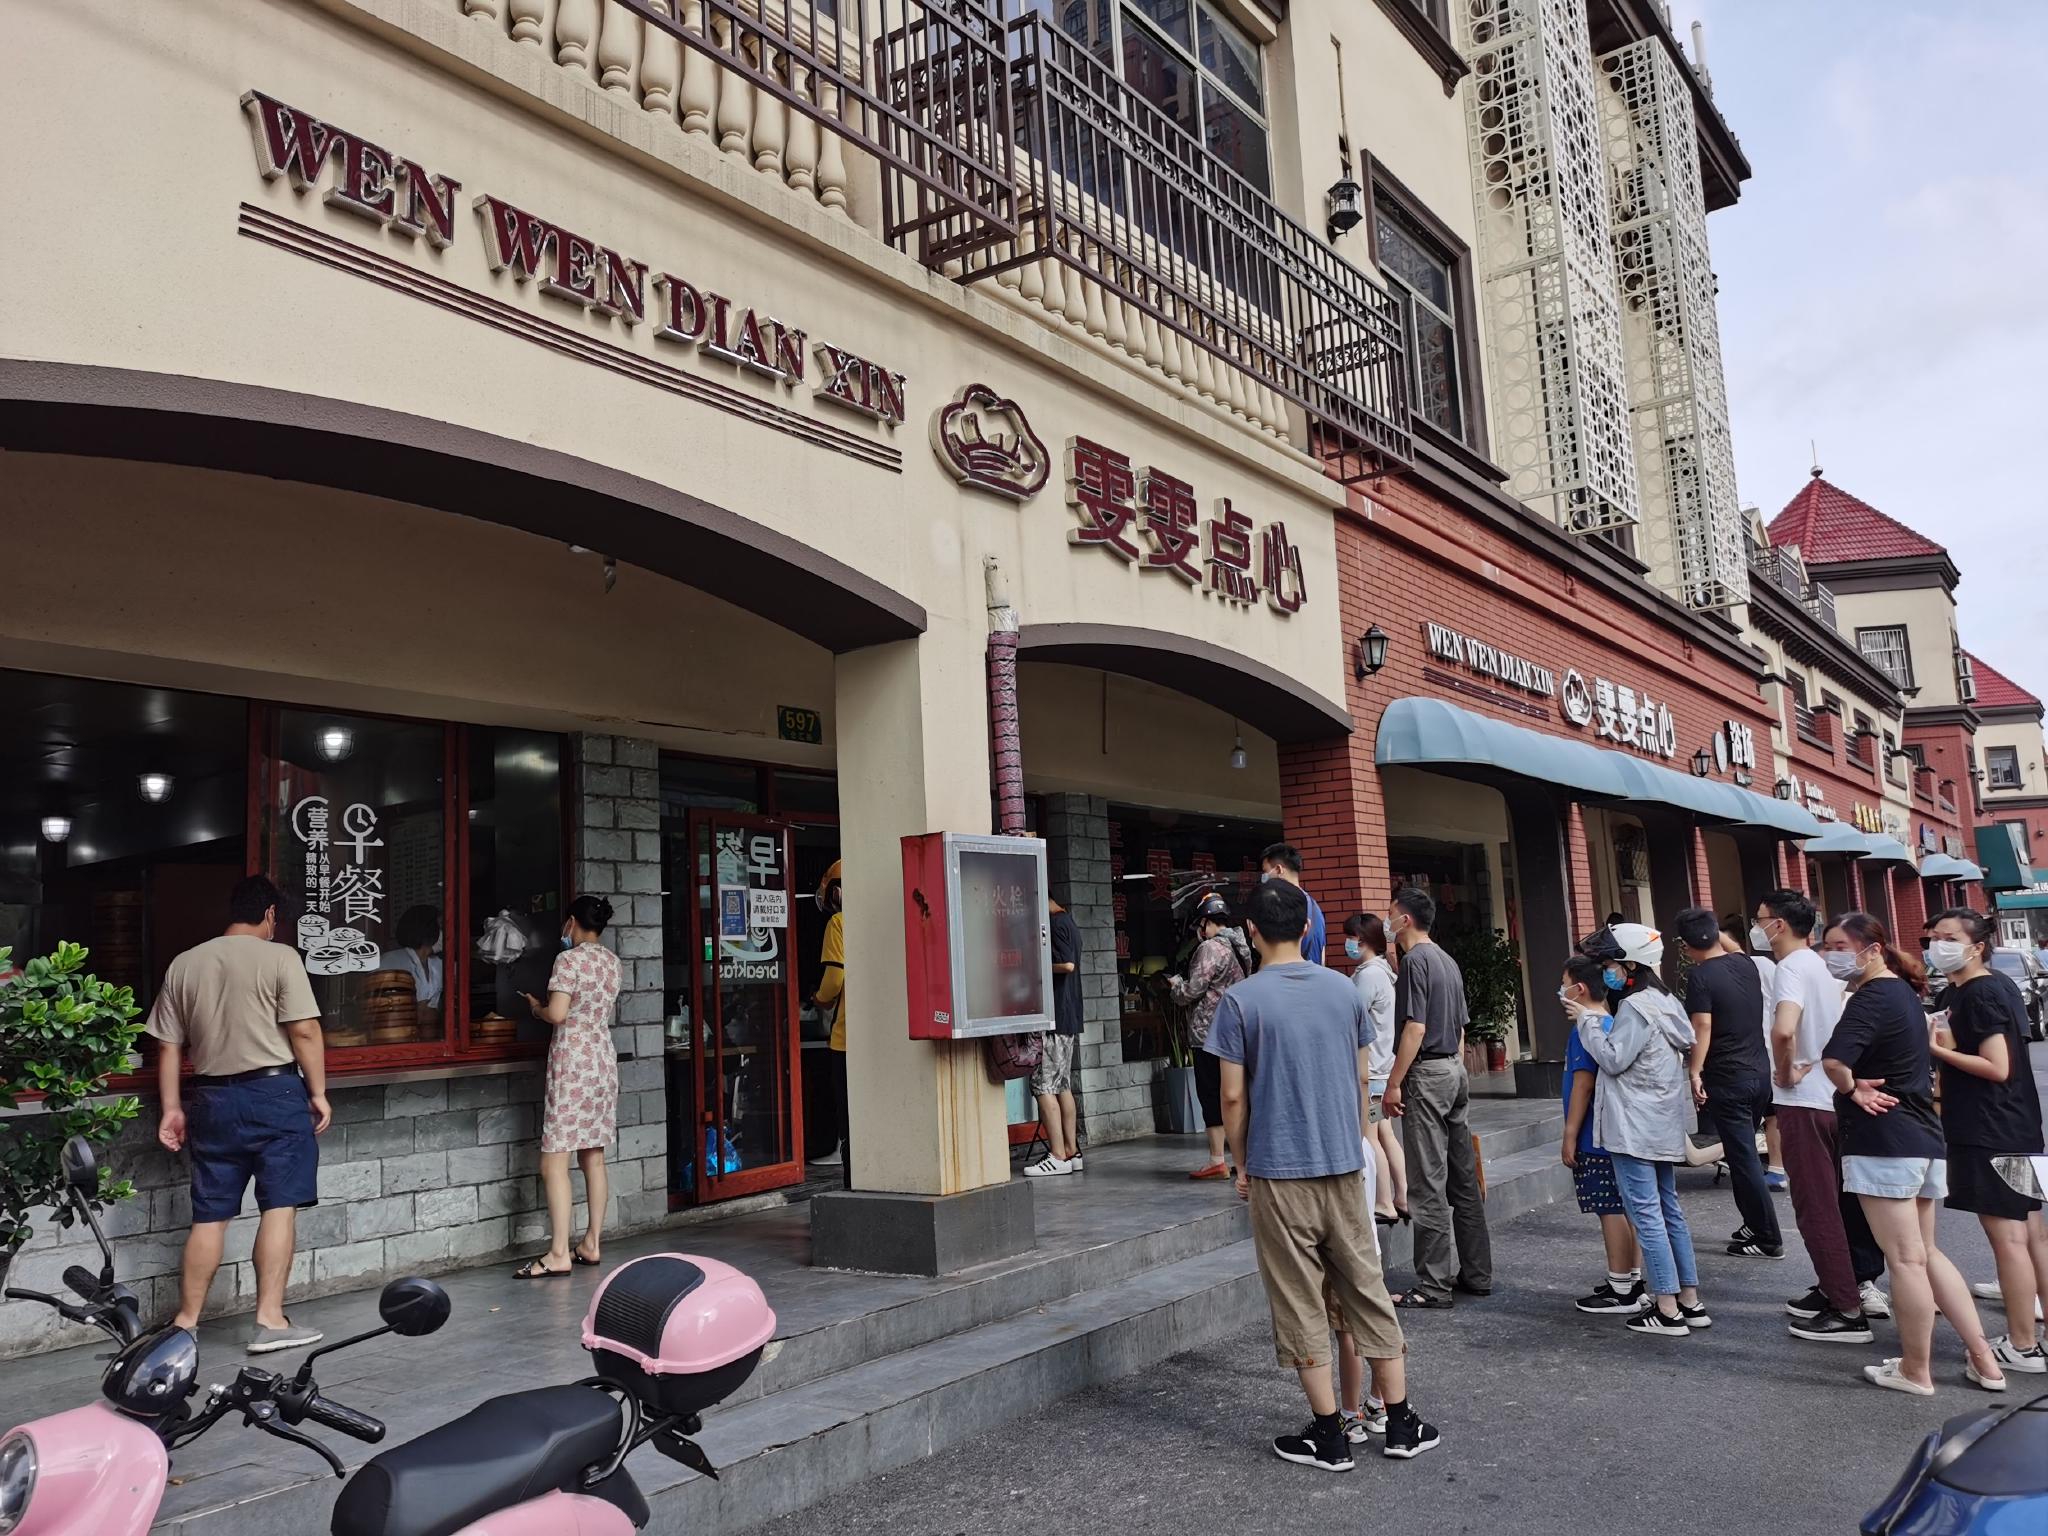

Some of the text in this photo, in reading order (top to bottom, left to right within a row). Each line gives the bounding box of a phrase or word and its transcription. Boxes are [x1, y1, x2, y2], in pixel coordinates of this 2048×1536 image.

[240, 89, 907, 426] WEN WEN DIAN XIN
[1065, 435, 1308, 614] 雯雯点心
[1427, 621, 1555, 696] WEN WEN DIAN XIN
[785, 710, 815, 732] 597
[1595, 676, 1677, 758] 雯雯点心
[306, 806, 329, 852] 营养
[305, 851, 318, 913] 精致的一天
[318, 853, 331, 913] 从早餐开始
[330, 803, 386, 924] 早餐
[753, 905, 786, 915] 请戴好口罩
[755, 894, 782, 904] 进入店内
